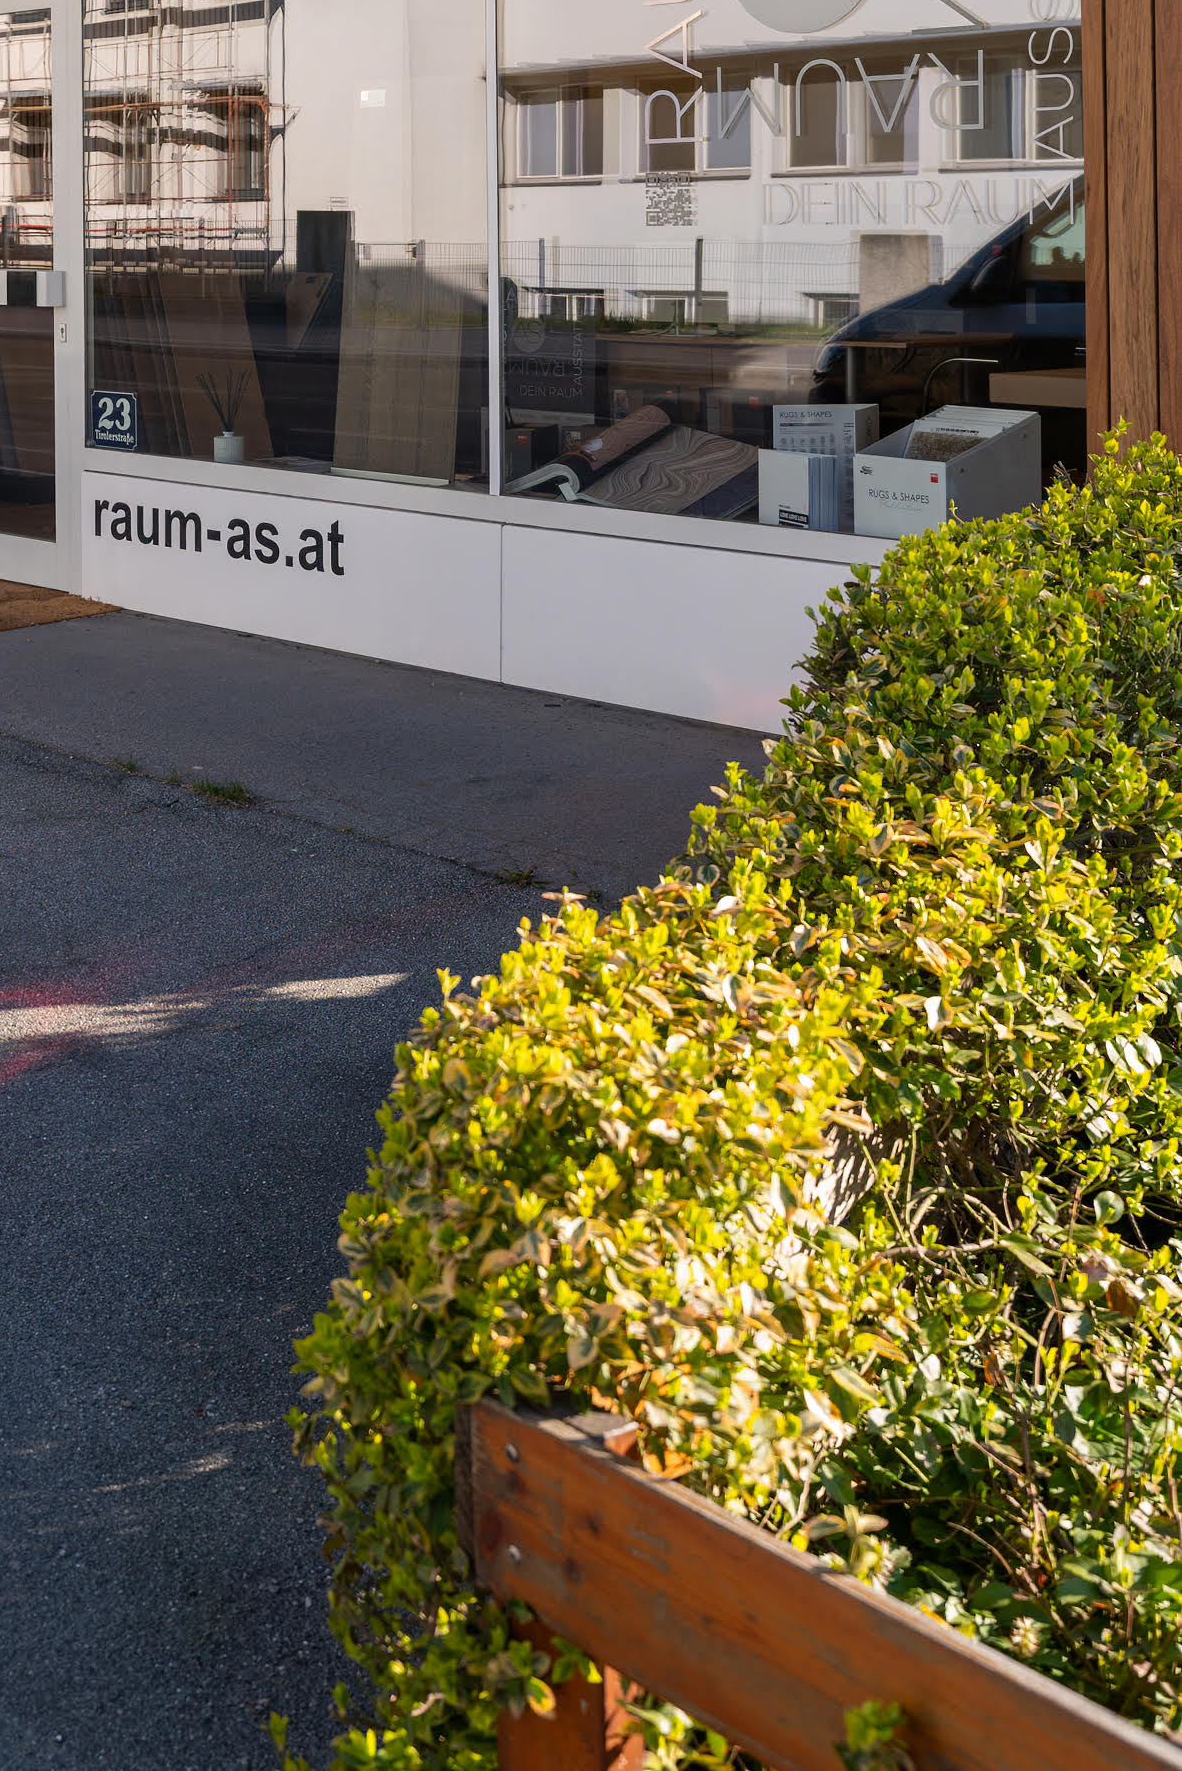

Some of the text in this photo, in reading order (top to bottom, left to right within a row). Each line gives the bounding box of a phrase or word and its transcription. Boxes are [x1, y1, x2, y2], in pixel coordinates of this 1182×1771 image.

[717, 48, 985, 140] RAUM
[762, 177, 1075, 227] DEIN RAUM
[548, 386, 583, 398] RAUM
[98, 397, 131, 431] 23
[868, 488, 930, 505] RUGS & SHAPES
[93, 498, 345, 576] raum-as.at
